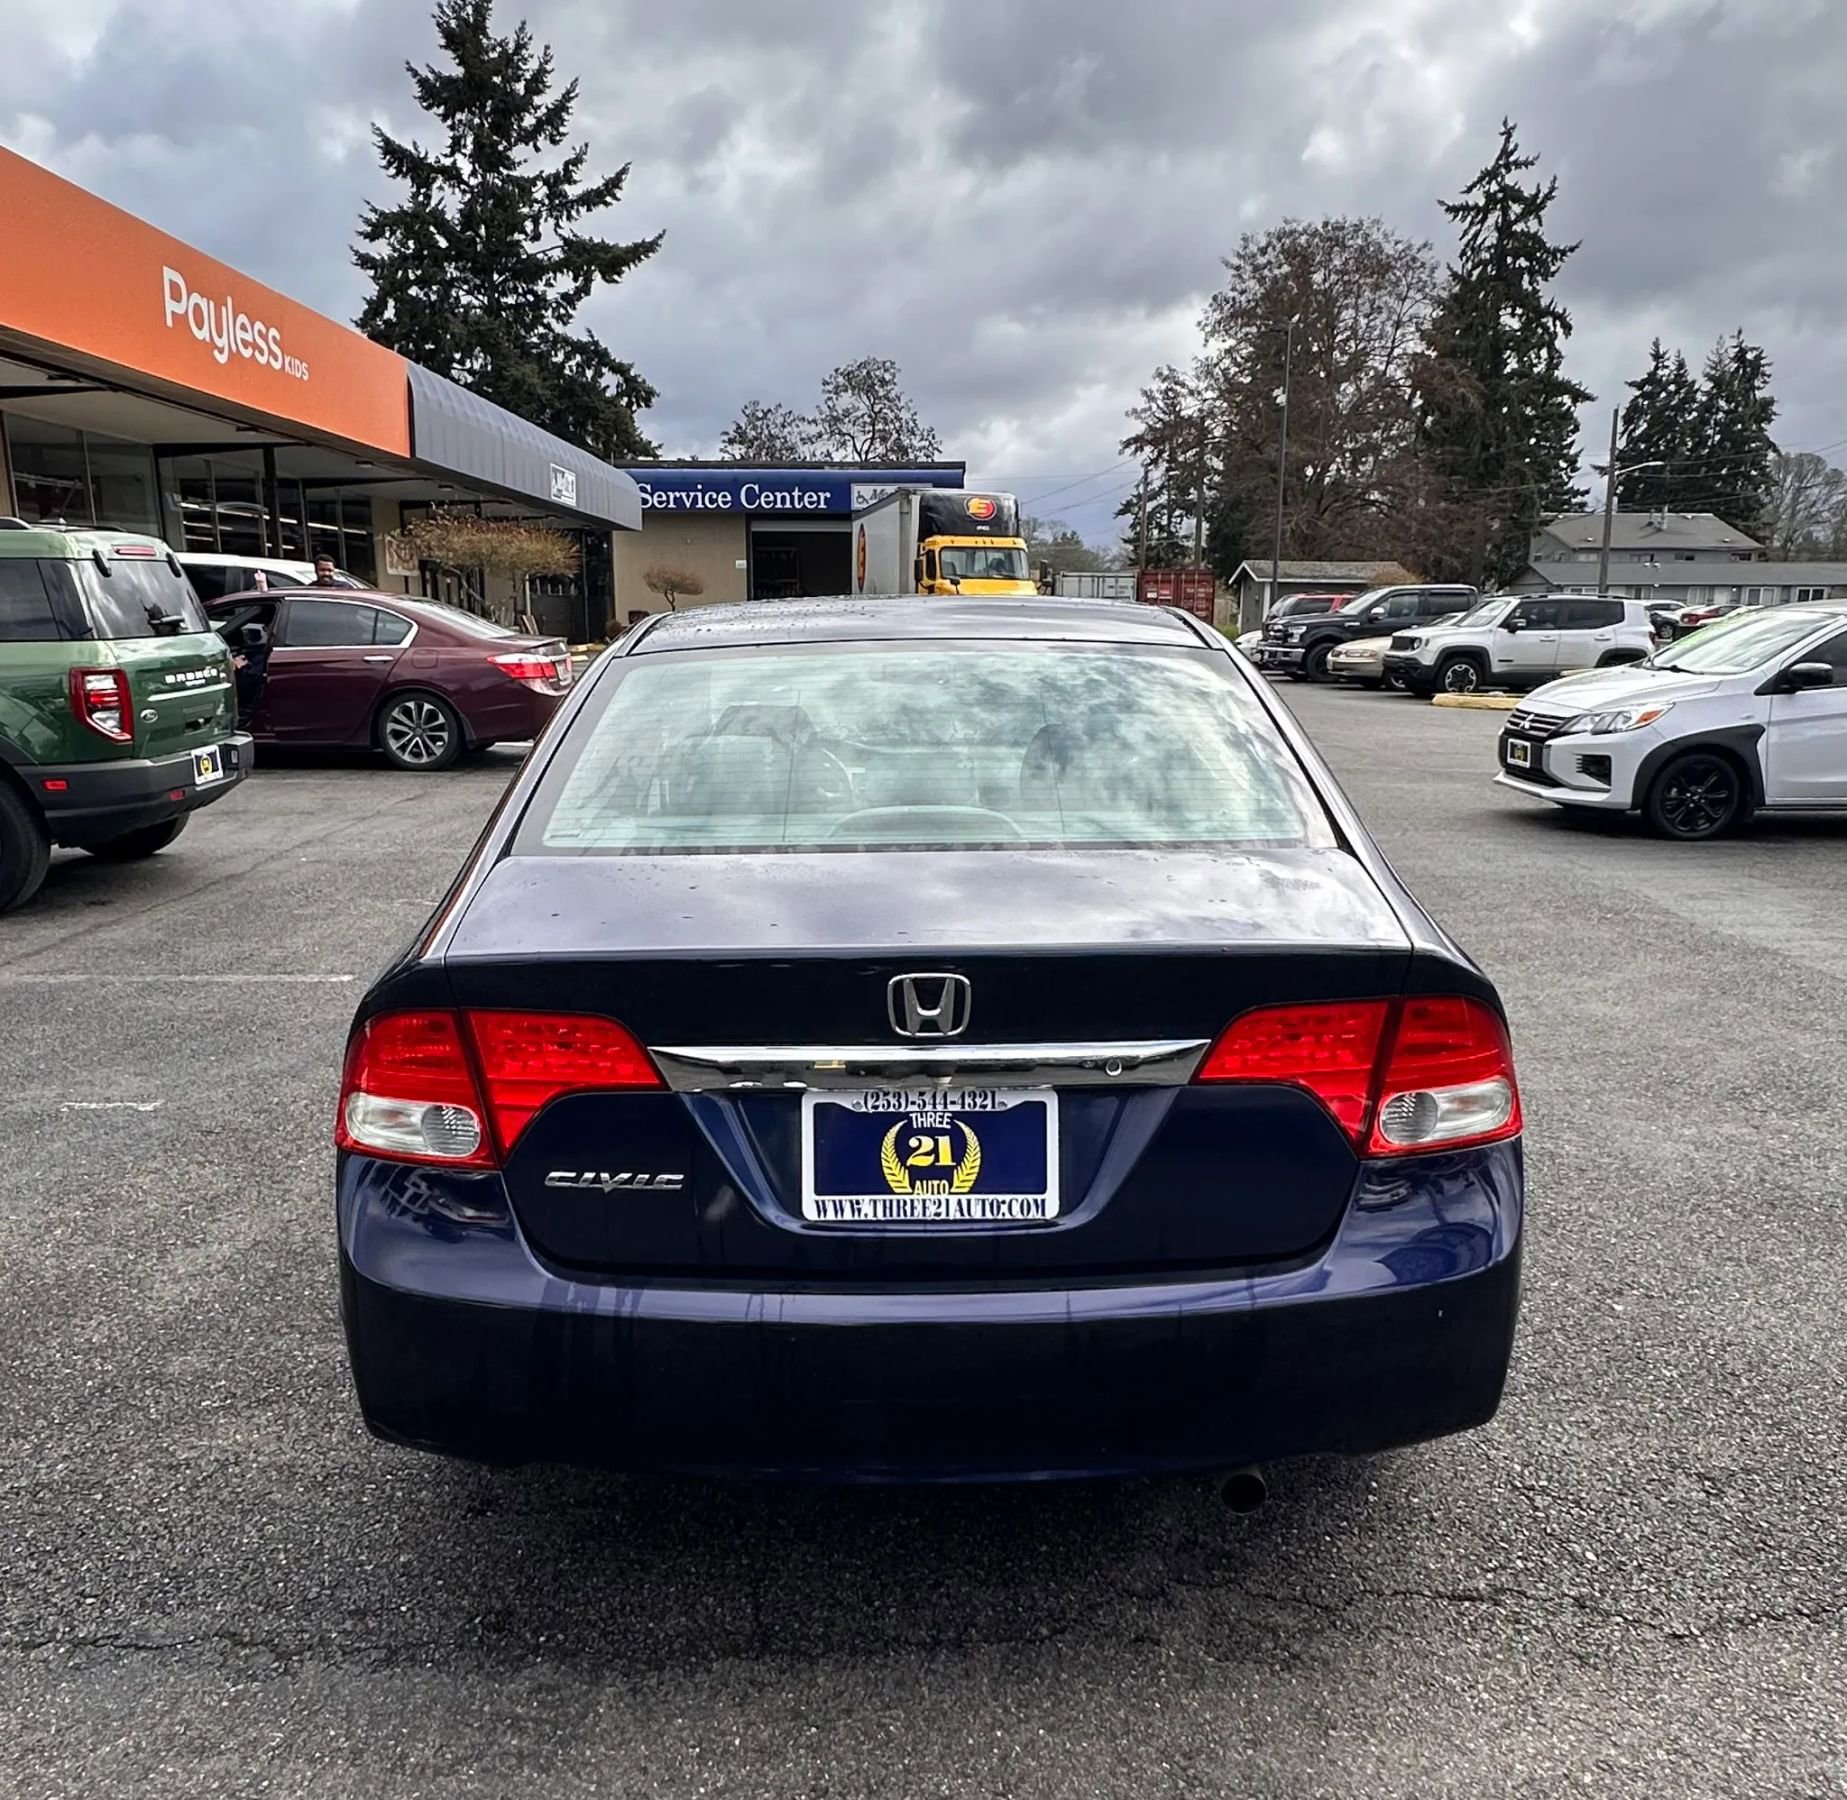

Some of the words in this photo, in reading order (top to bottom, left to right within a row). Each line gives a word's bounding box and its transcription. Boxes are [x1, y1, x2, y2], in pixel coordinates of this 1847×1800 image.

[162, 265, 283, 370] Payless
[283, 354, 309, 381] KIDS
[638, 482, 732, 509] Service
[740, 483, 831, 510] Center
[862, 1090, 997, 1111] (253)-544-4321
[909, 1112, 952, 1129] THREE
[906, 1135, 956, 1167] 21
[544, 1171, 684, 1194] CIVIC
[913, 1180, 950, 1196] AUTO
